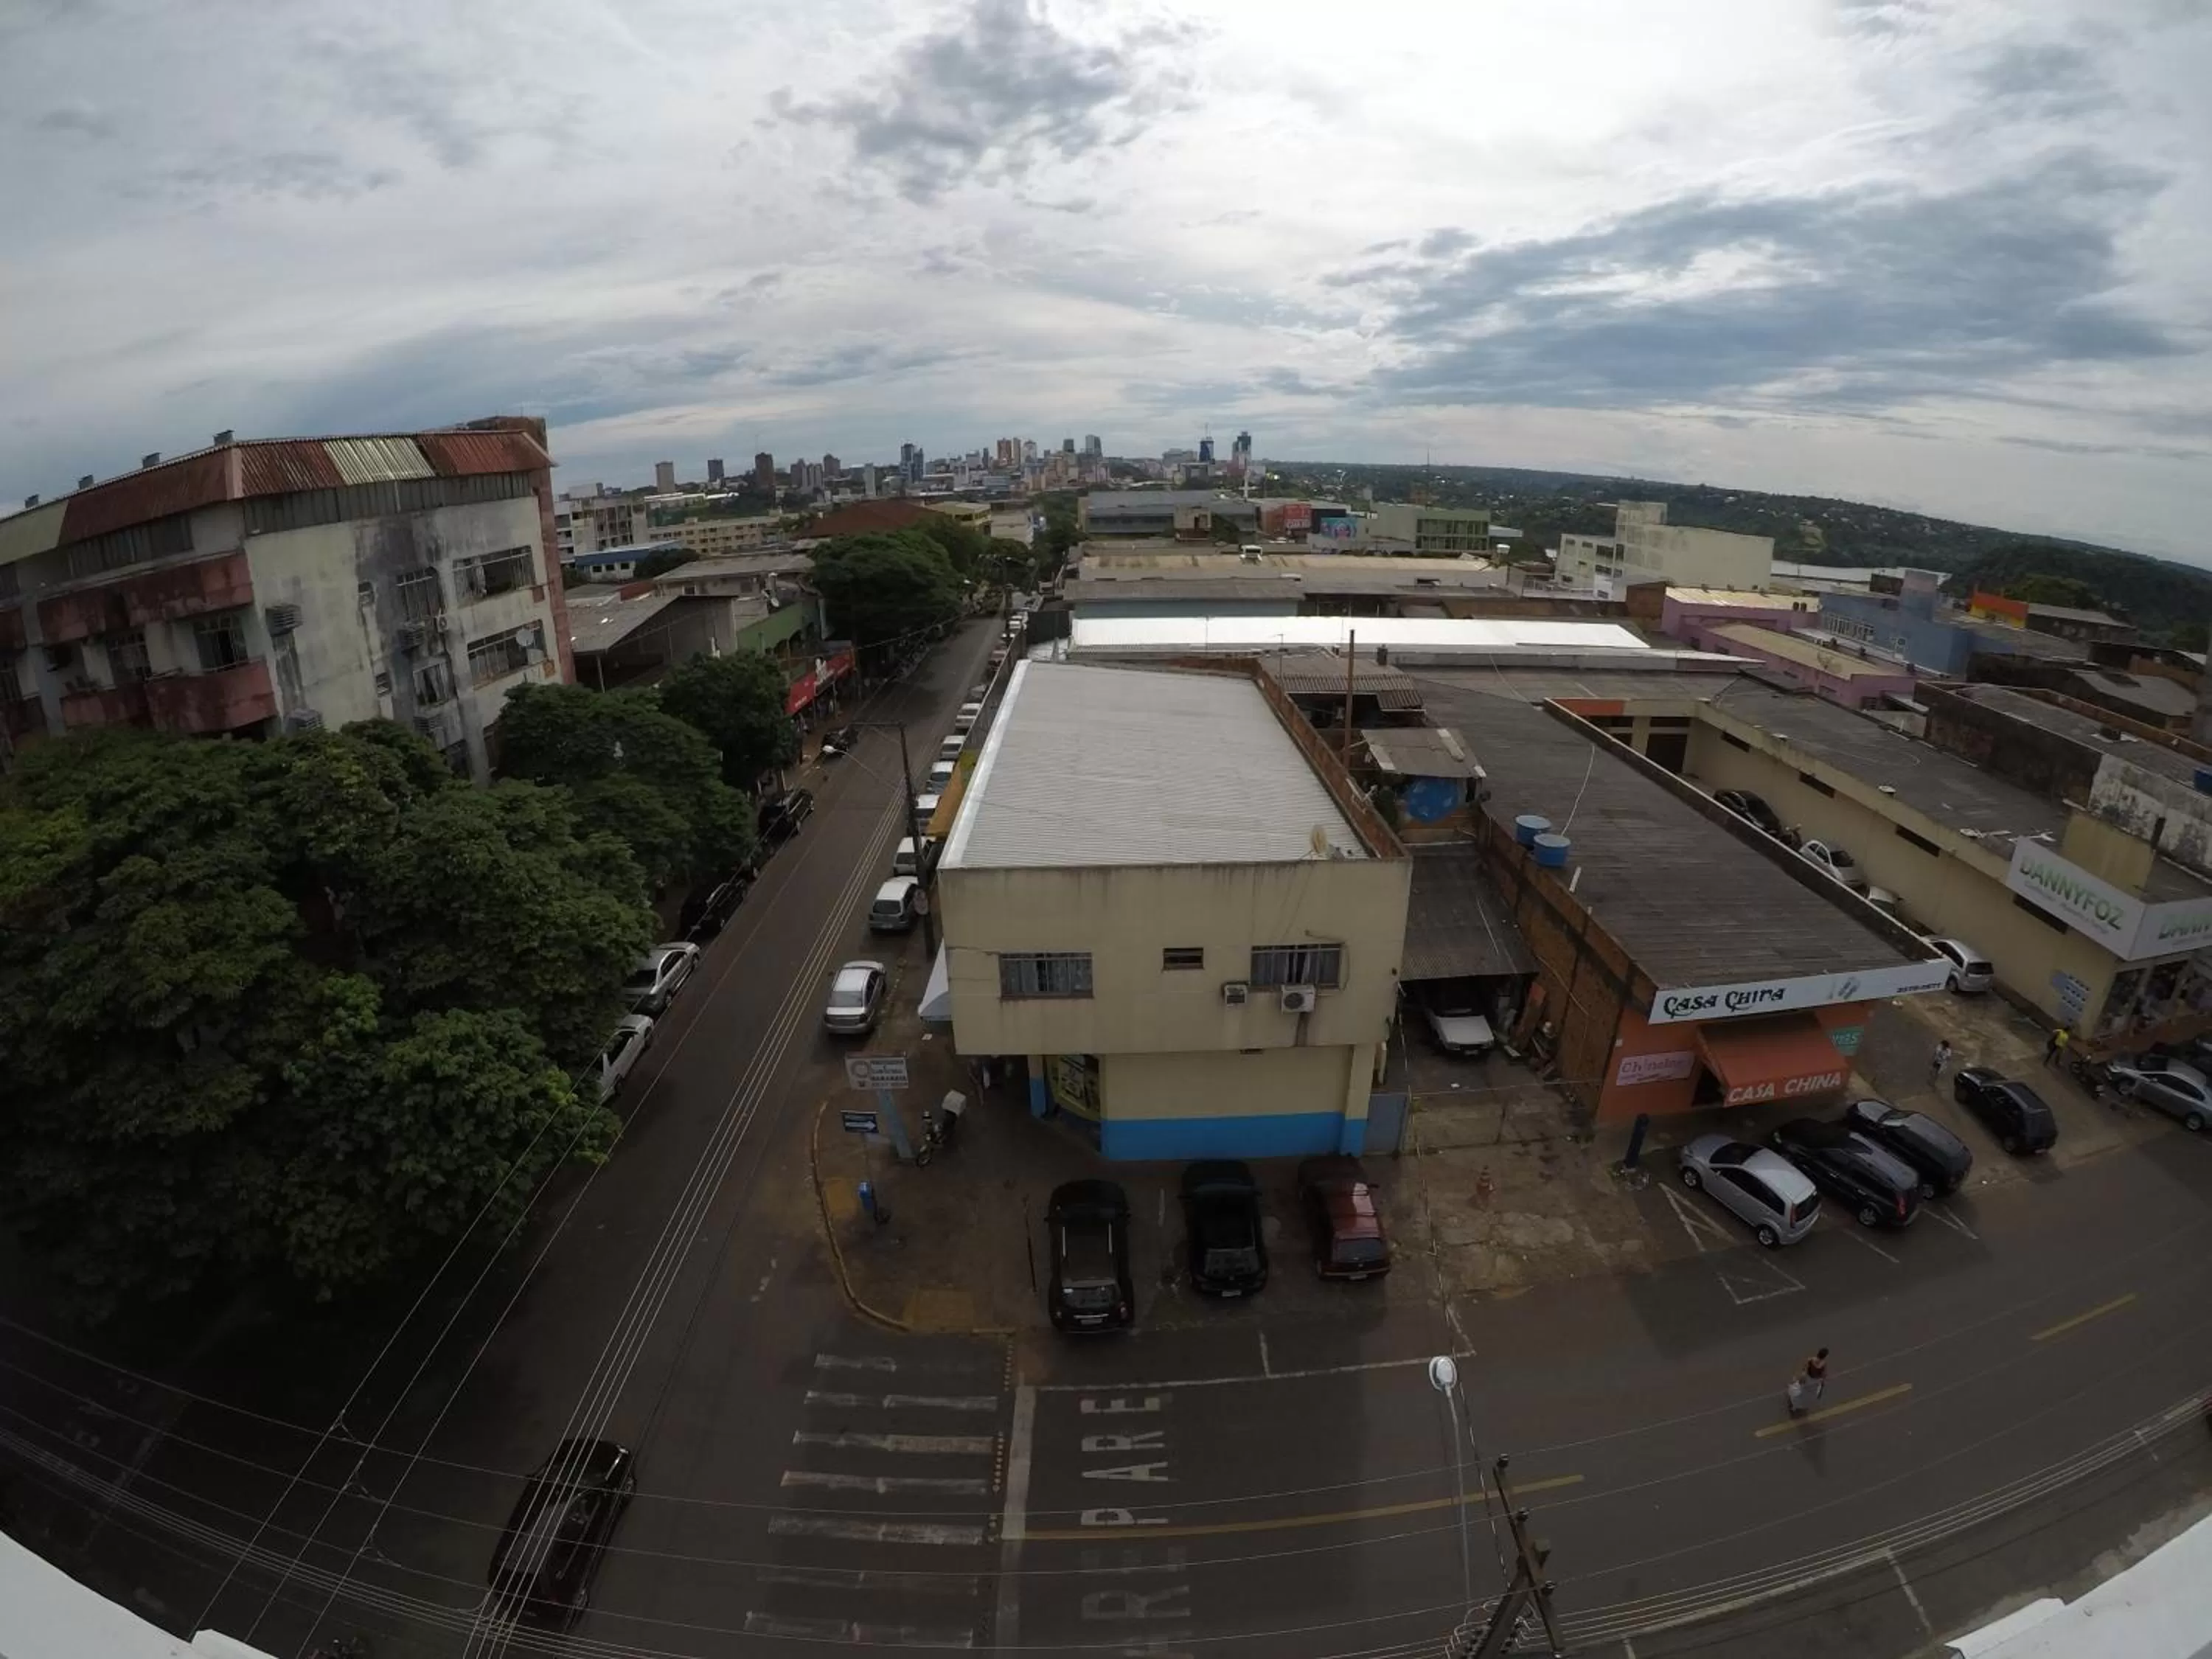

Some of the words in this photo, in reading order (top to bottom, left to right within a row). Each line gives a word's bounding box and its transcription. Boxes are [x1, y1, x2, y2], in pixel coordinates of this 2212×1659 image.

[2020, 855, 2125, 931] DANNYFOZ
[1663, 995, 1718, 1019] CASA
[1728, 1082, 1775, 1102] CASA
[1784, 1071, 1841, 1094] CHINA
[1080, 1396, 1169, 1526] PARE
